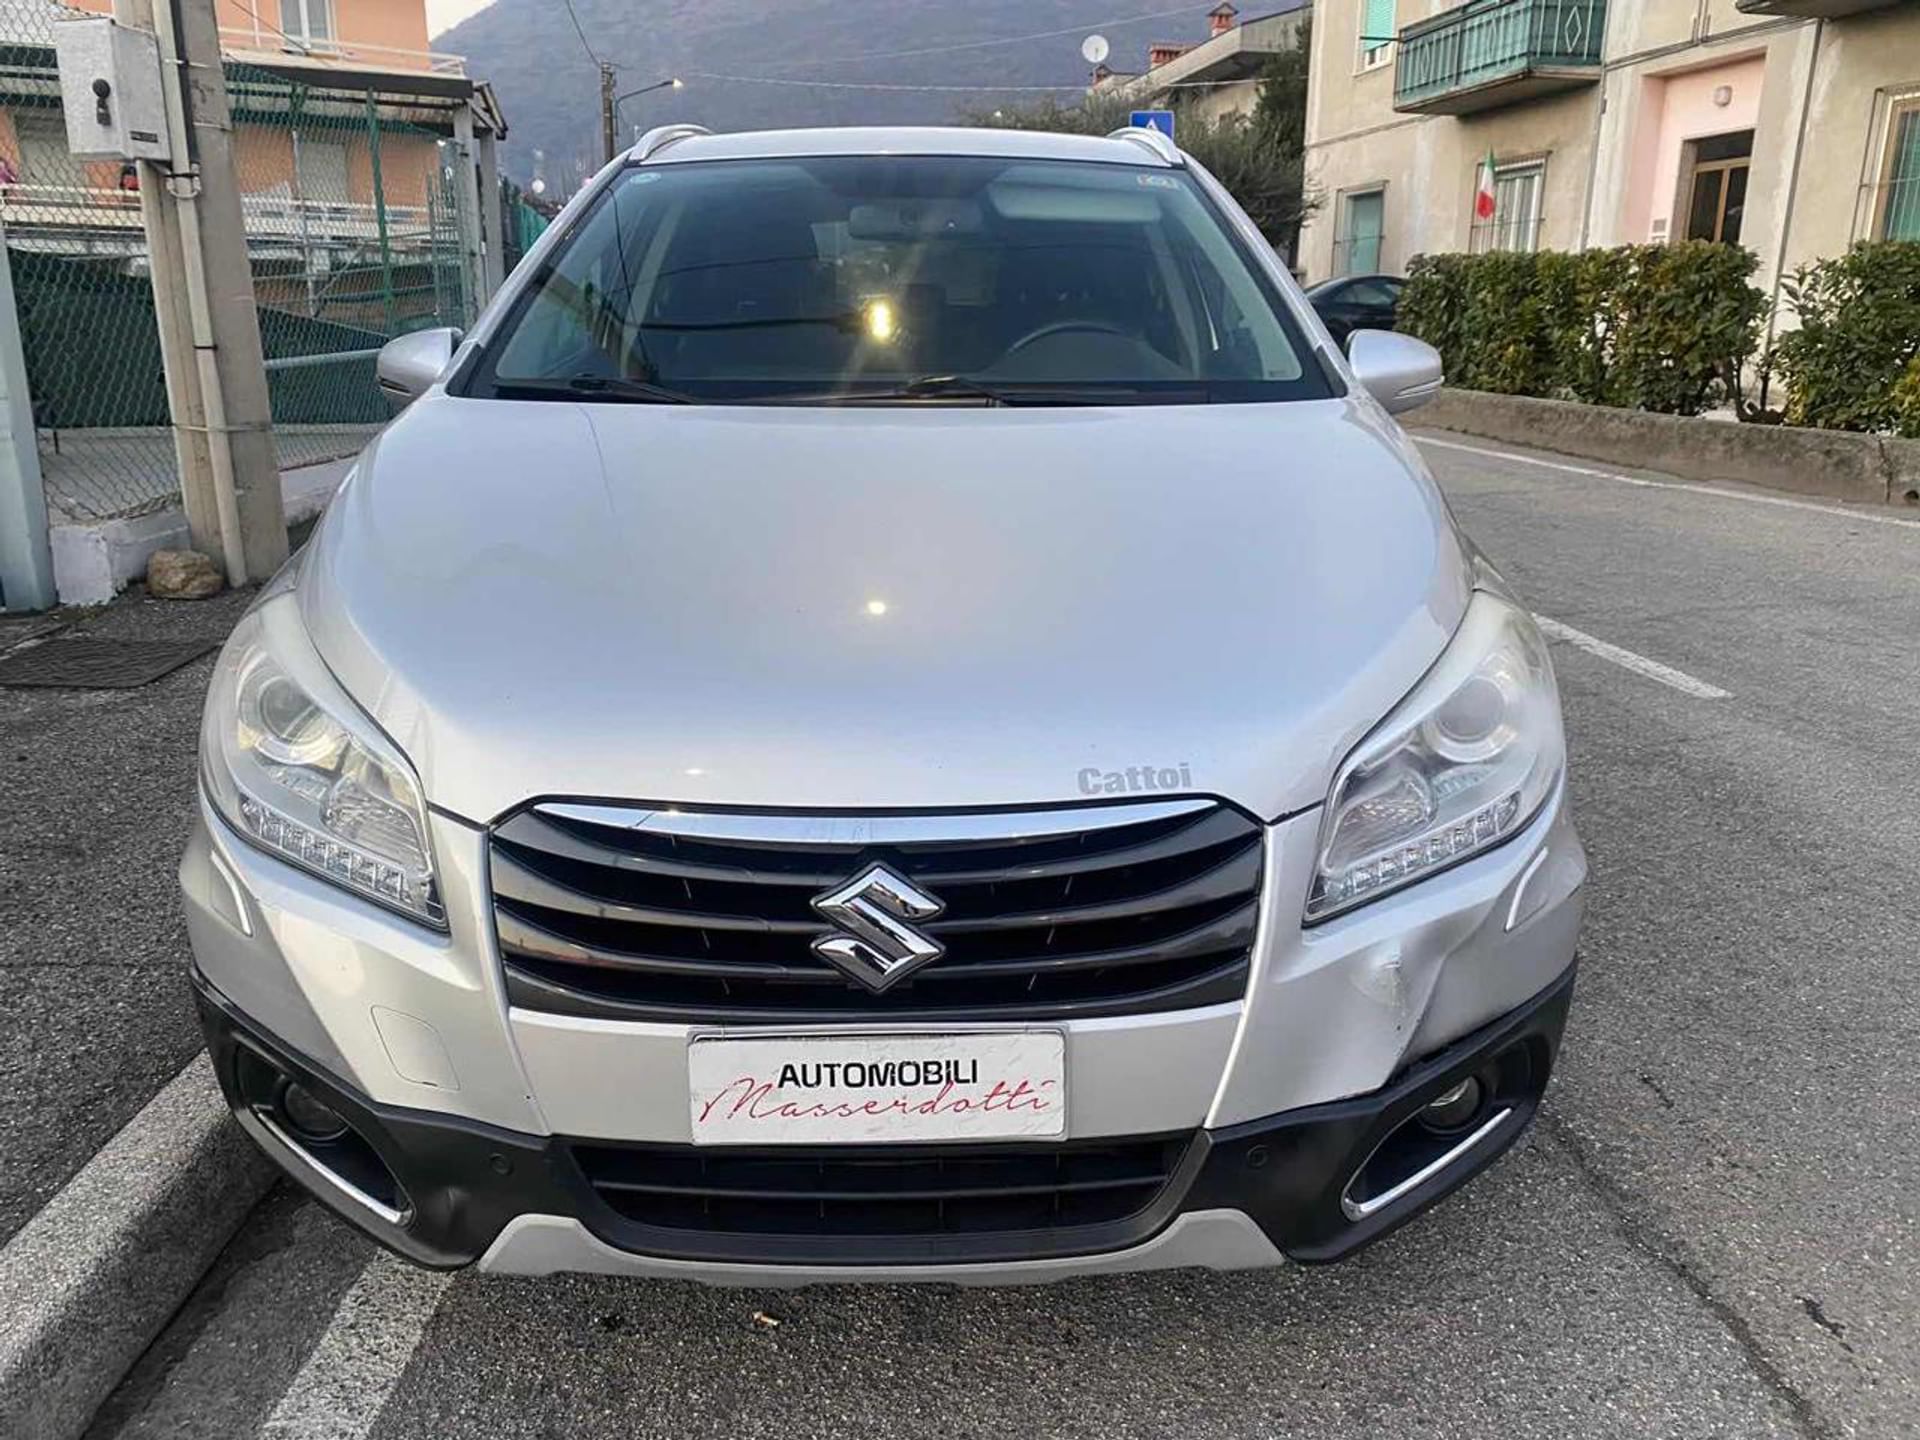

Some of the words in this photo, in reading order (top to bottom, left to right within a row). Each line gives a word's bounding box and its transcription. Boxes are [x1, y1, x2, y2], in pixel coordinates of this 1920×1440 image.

[1077, 762, 1192, 795] Cattoi
[777, 1059, 978, 1088] AUTOMOBILI
[699, 1077, 1056, 1123] Masserdotti
